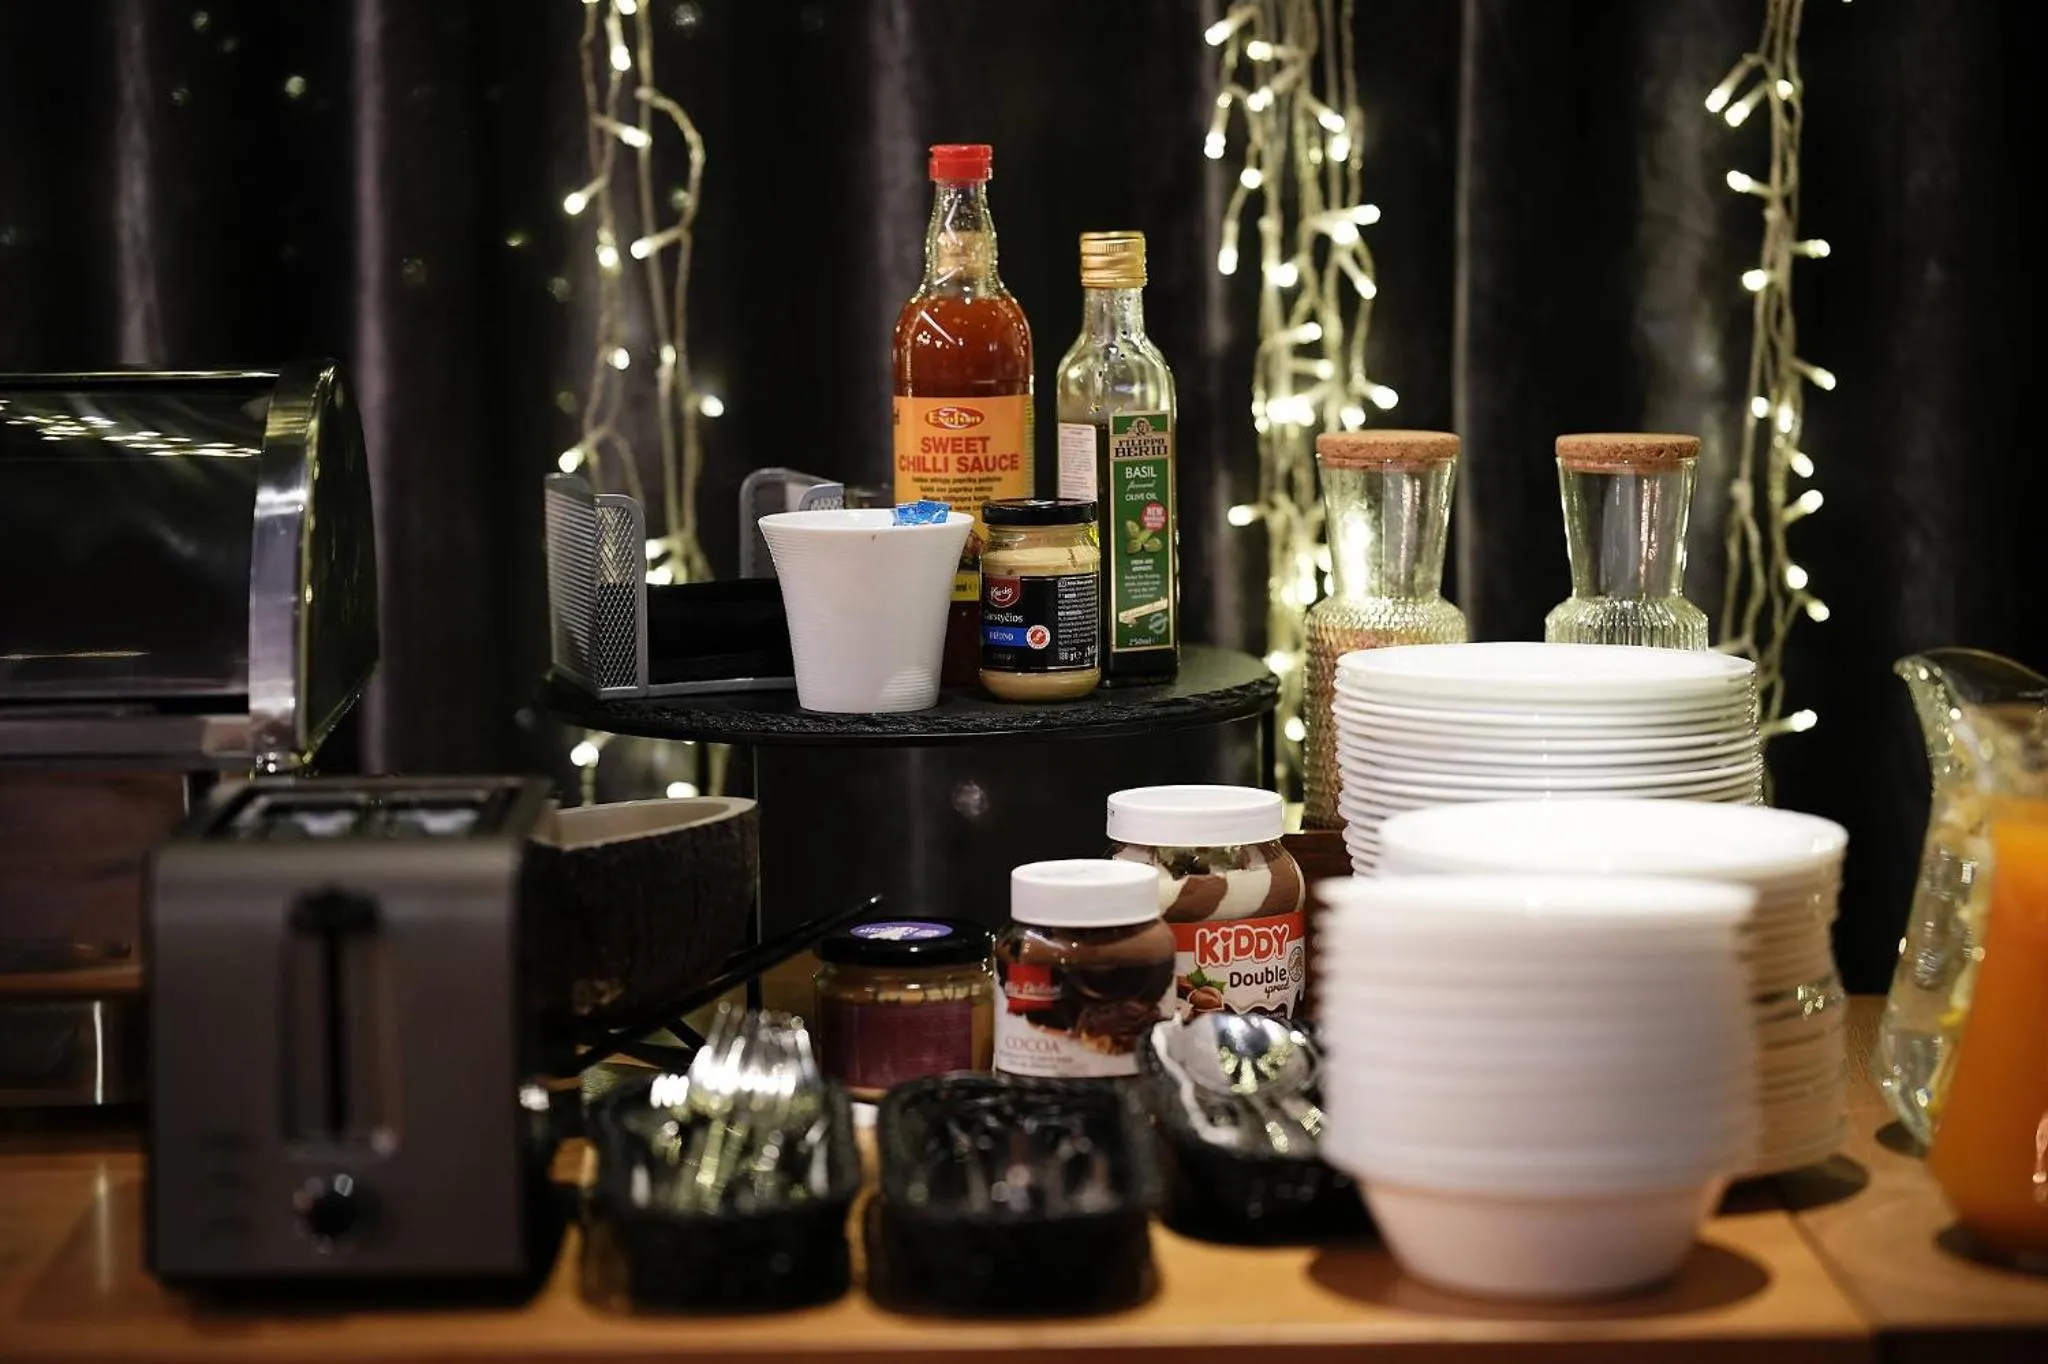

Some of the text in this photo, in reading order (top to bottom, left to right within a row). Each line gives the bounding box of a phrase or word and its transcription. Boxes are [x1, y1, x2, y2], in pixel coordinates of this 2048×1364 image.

[920, 437, 990, 454] SWEET
[1118, 437, 1165, 447] FILIPPO
[1114, 446, 1168, 458] BERIO
[898, 453, 1019, 473] CHILLI SAUCE
[1125, 466, 1157, 479] BASIL
[1125, 492, 1157, 501] OLIVE OIL
[1229, 965, 1288, 988] Double
[1004, 1037, 1061, 1053] COCOA
